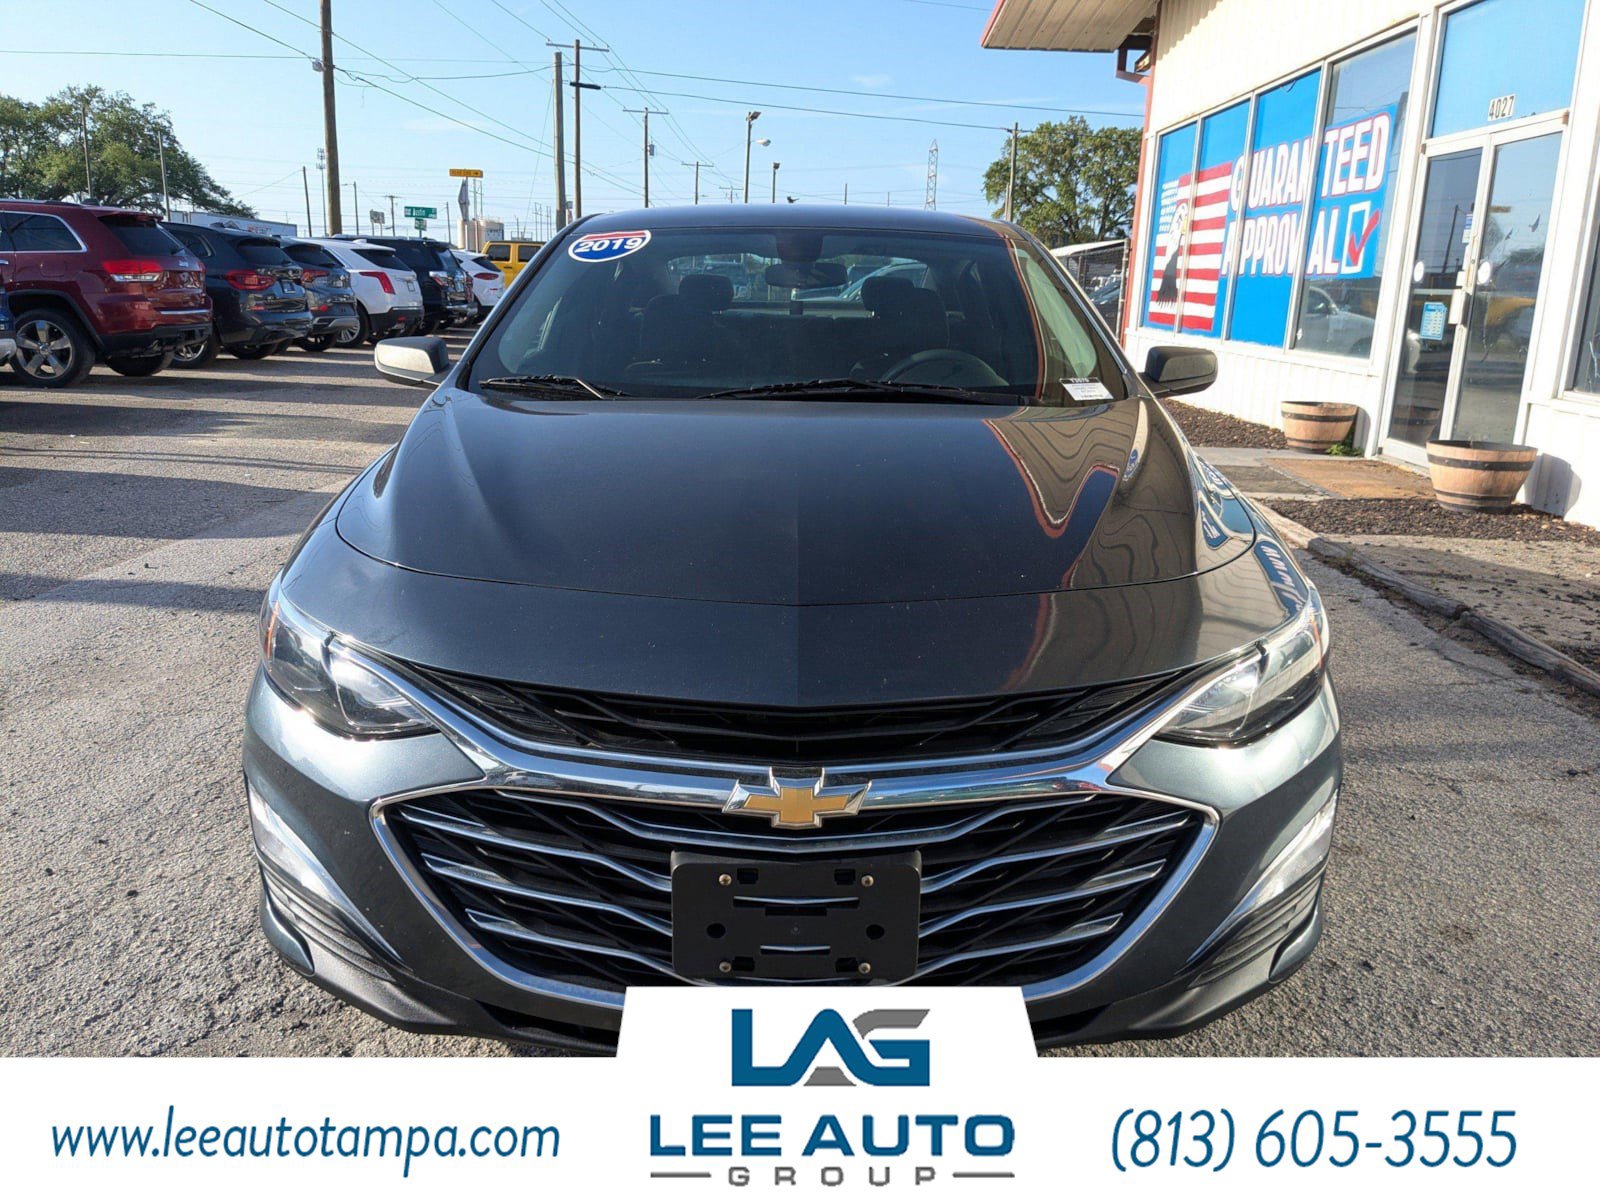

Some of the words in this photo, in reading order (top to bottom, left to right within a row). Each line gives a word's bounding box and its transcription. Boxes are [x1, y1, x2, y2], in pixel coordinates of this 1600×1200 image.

[1488, 95, 1515, 120] 4027
[1230, 112, 1391, 213] GUARANTEED
[574, 237, 643, 253] 2019
[1221, 207, 1341, 277] APPROVAL
